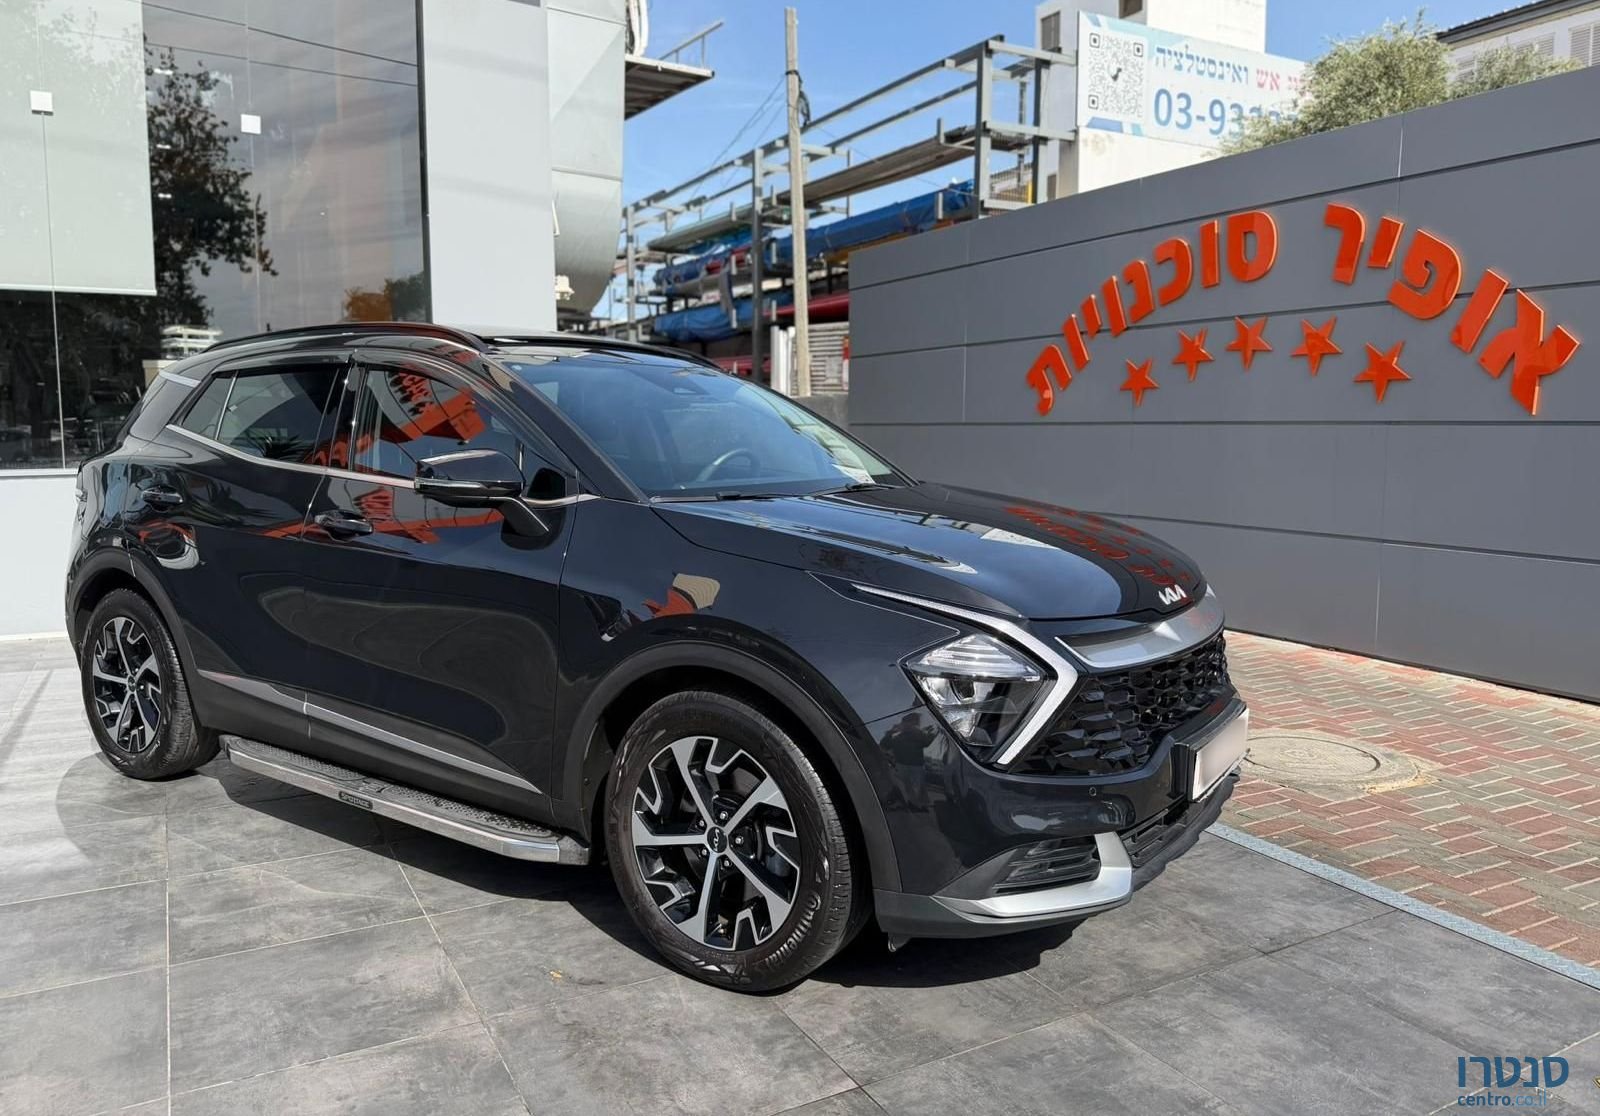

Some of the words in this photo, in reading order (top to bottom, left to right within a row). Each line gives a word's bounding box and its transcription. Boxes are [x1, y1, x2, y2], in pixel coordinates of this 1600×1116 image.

[1153, 44, 1249, 85] ואינסטלציה
[1256, 68, 1281, 90] אש
[1025, 210, 1278, 416] סוכנויות
[1325, 203, 1579, 415] אופיר
[1158, 584, 1187, 605] KIA
